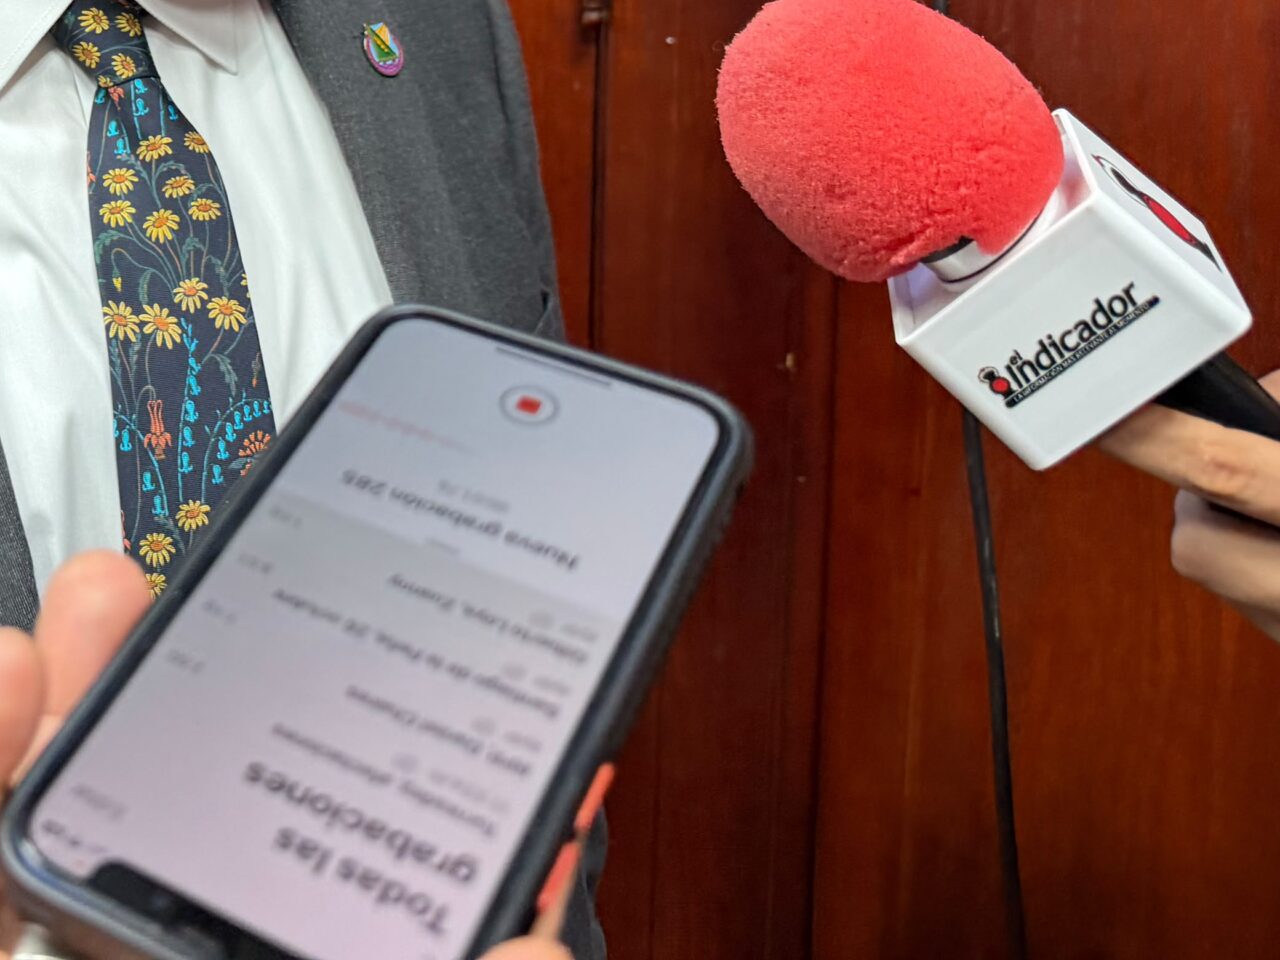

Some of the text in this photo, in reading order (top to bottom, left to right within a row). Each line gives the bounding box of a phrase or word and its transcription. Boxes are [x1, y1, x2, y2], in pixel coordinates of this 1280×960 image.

[1003, 281, 1136, 389] el Indicador
[336, 466, 388, 497] 285
[385, 482, 503, 542] grabación
[500, 527, 580, 571] Nueva
[236, 749, 482, 898] grabaciones
[267, 821, 455, 938] Todas las
